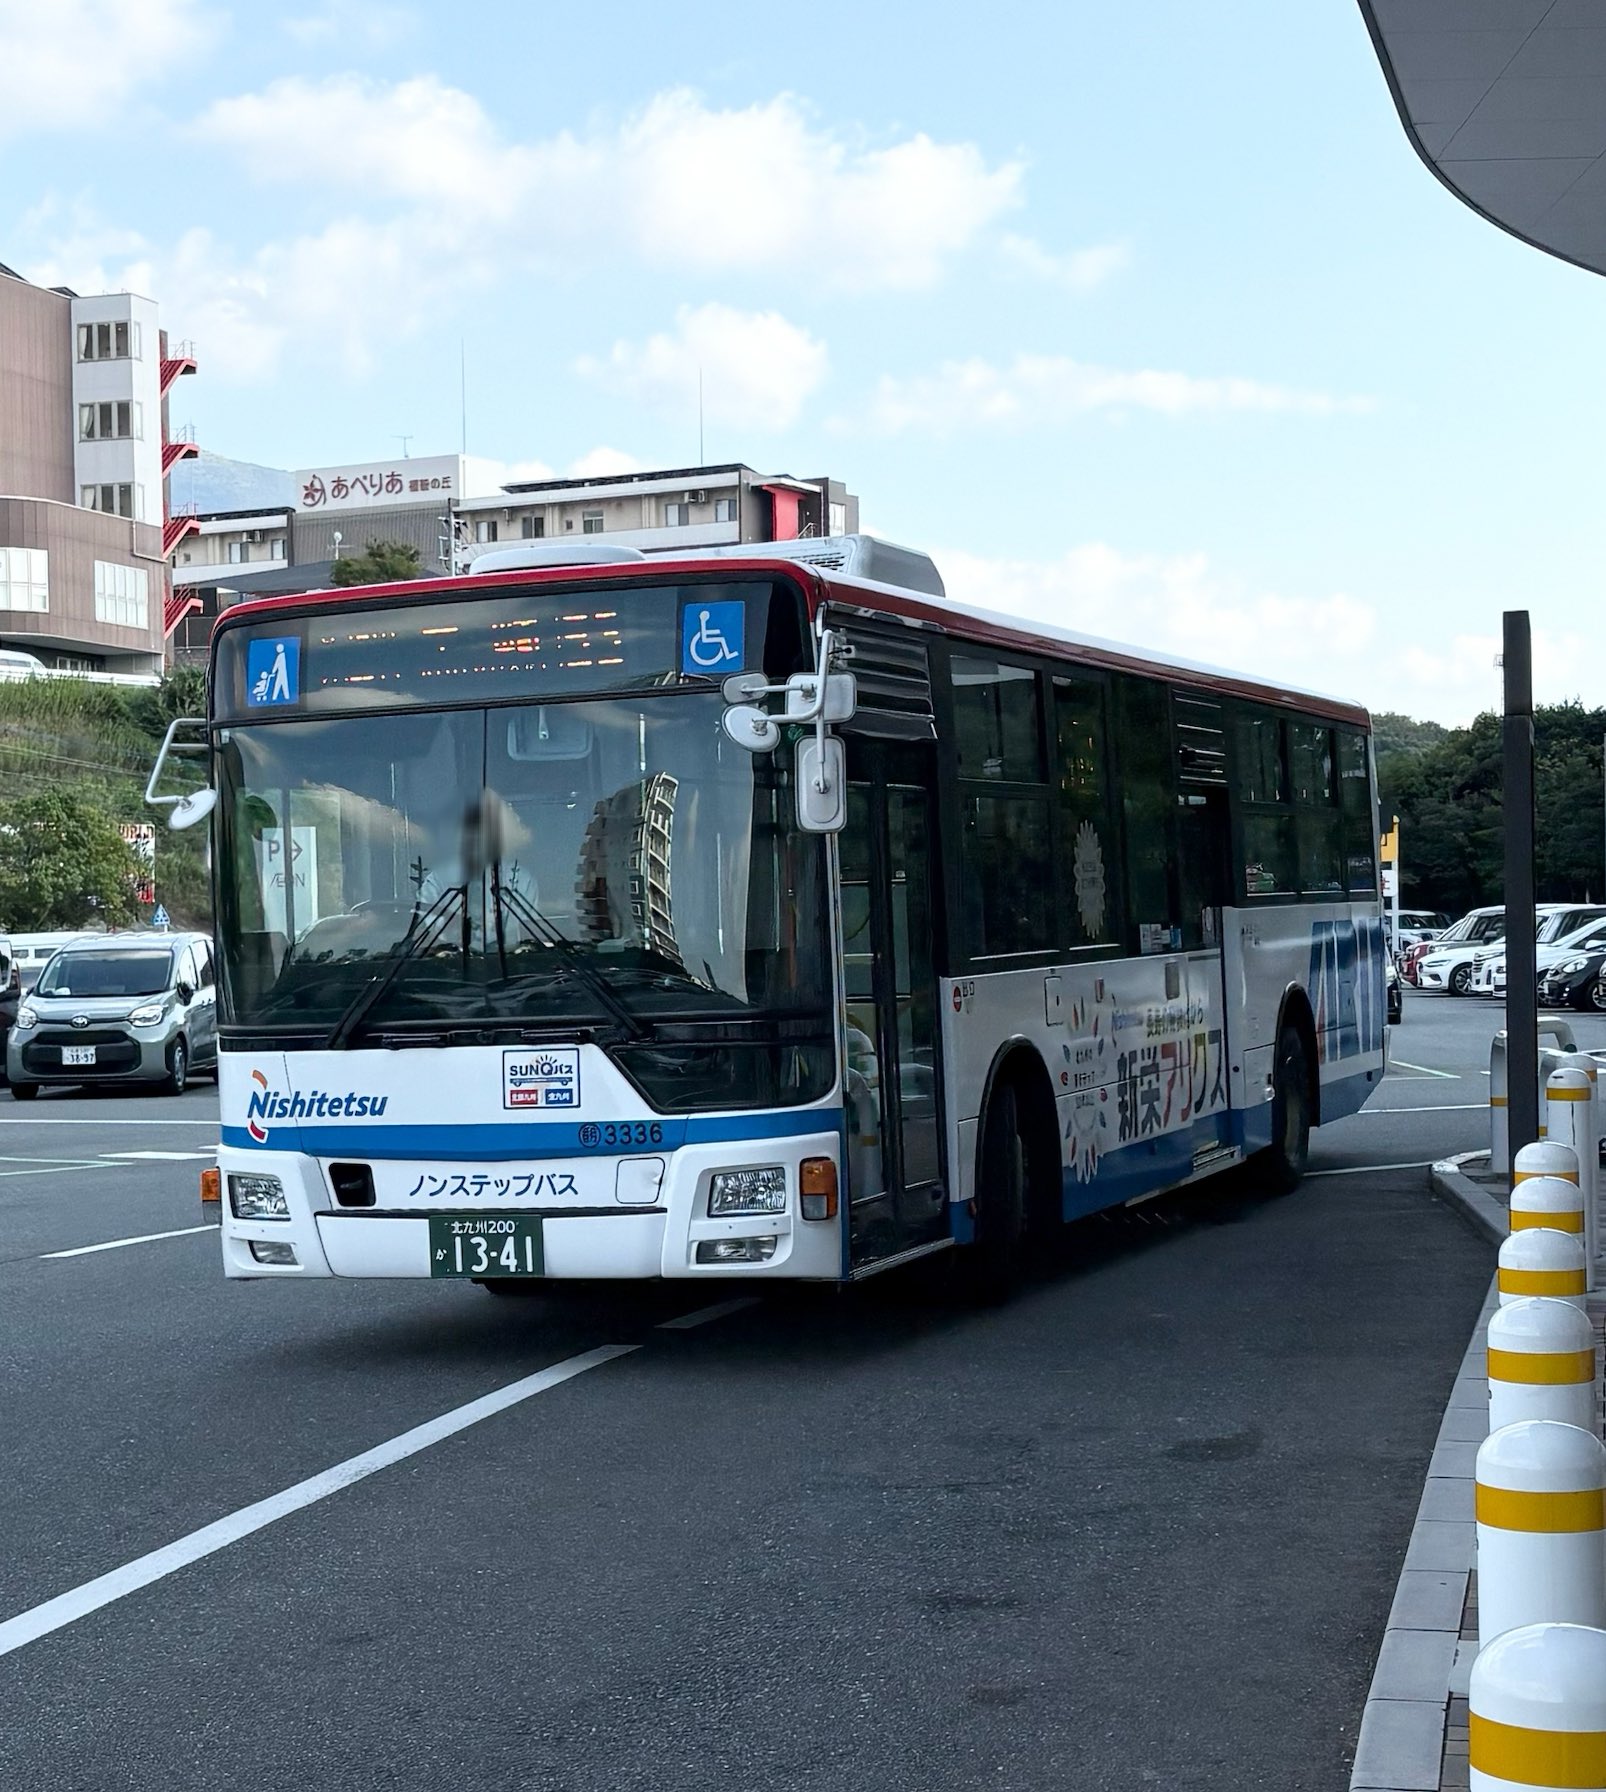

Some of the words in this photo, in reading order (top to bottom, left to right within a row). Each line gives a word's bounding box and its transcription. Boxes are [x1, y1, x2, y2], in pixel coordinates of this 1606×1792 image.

[268, 839, 281, 862] P
[247, 1090, 388, 1119] Nishitetsu
[604, 1122, 663, 1145] 3336
[409, 1173, 579, 1197] ノンステップバス
[451, 1220, 516, 1234] 北九州200
[436, 1248, 447, 1261] か
[454, 1235, 534, 1273] 13-41
